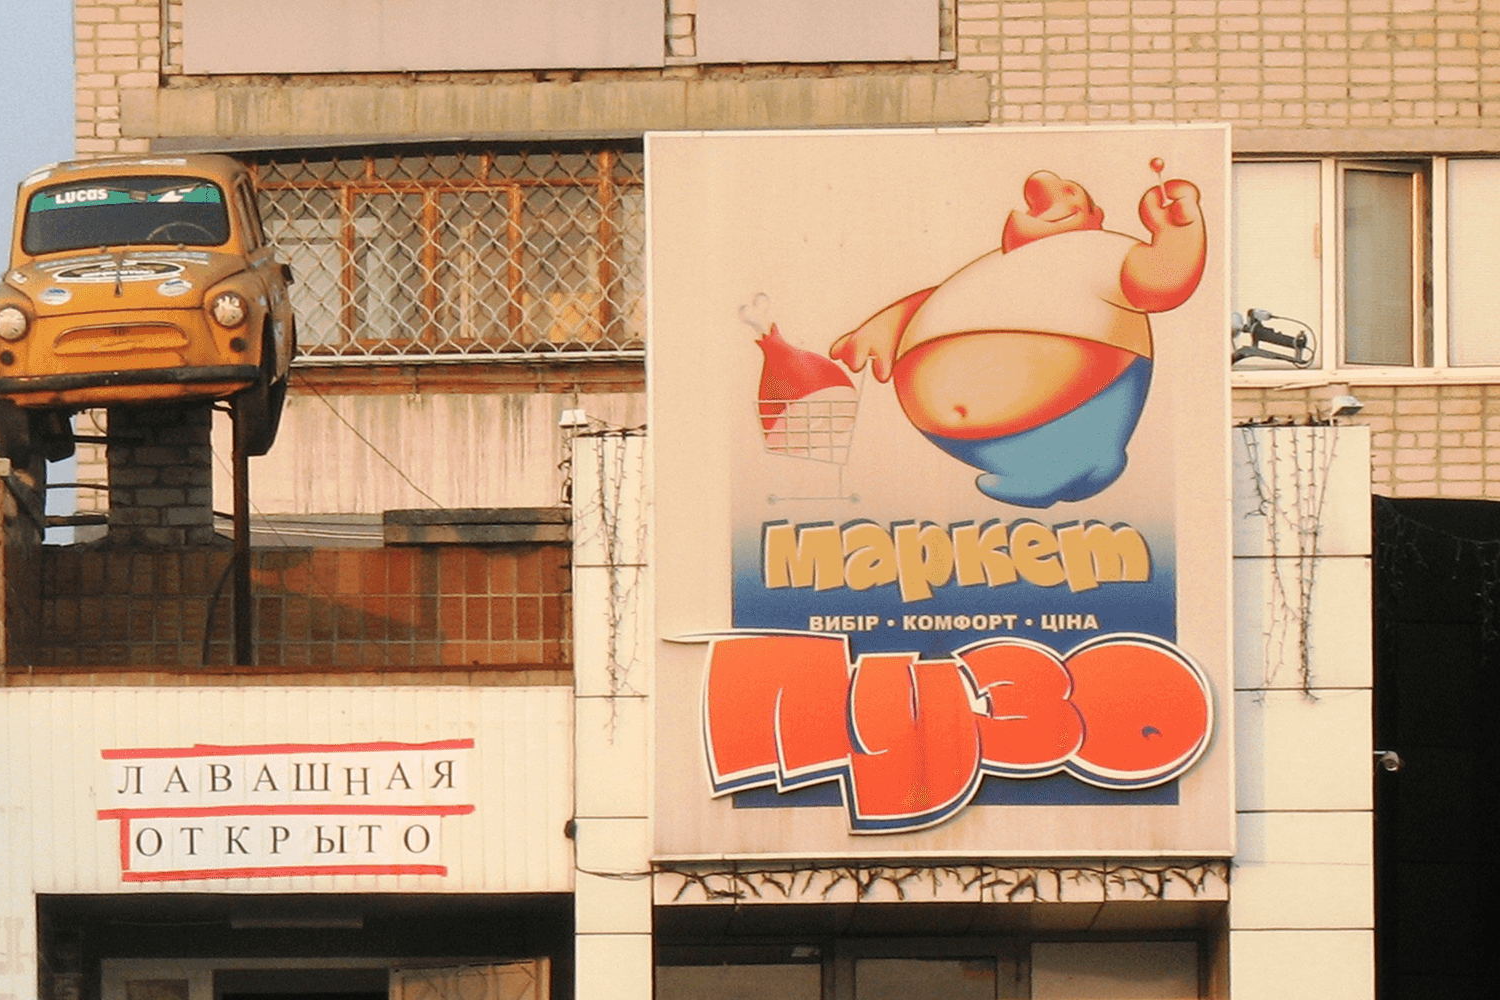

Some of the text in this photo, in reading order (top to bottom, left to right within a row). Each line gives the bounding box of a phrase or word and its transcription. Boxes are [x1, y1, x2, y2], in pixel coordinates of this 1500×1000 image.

[809, 614, 1099, 632] ВИБІР КОМФОРТ ЦІНА
[117, 760, 456, 796] ЛАВАШНАЯ
[135, 823, 431, 857] ОТКРЫТО
